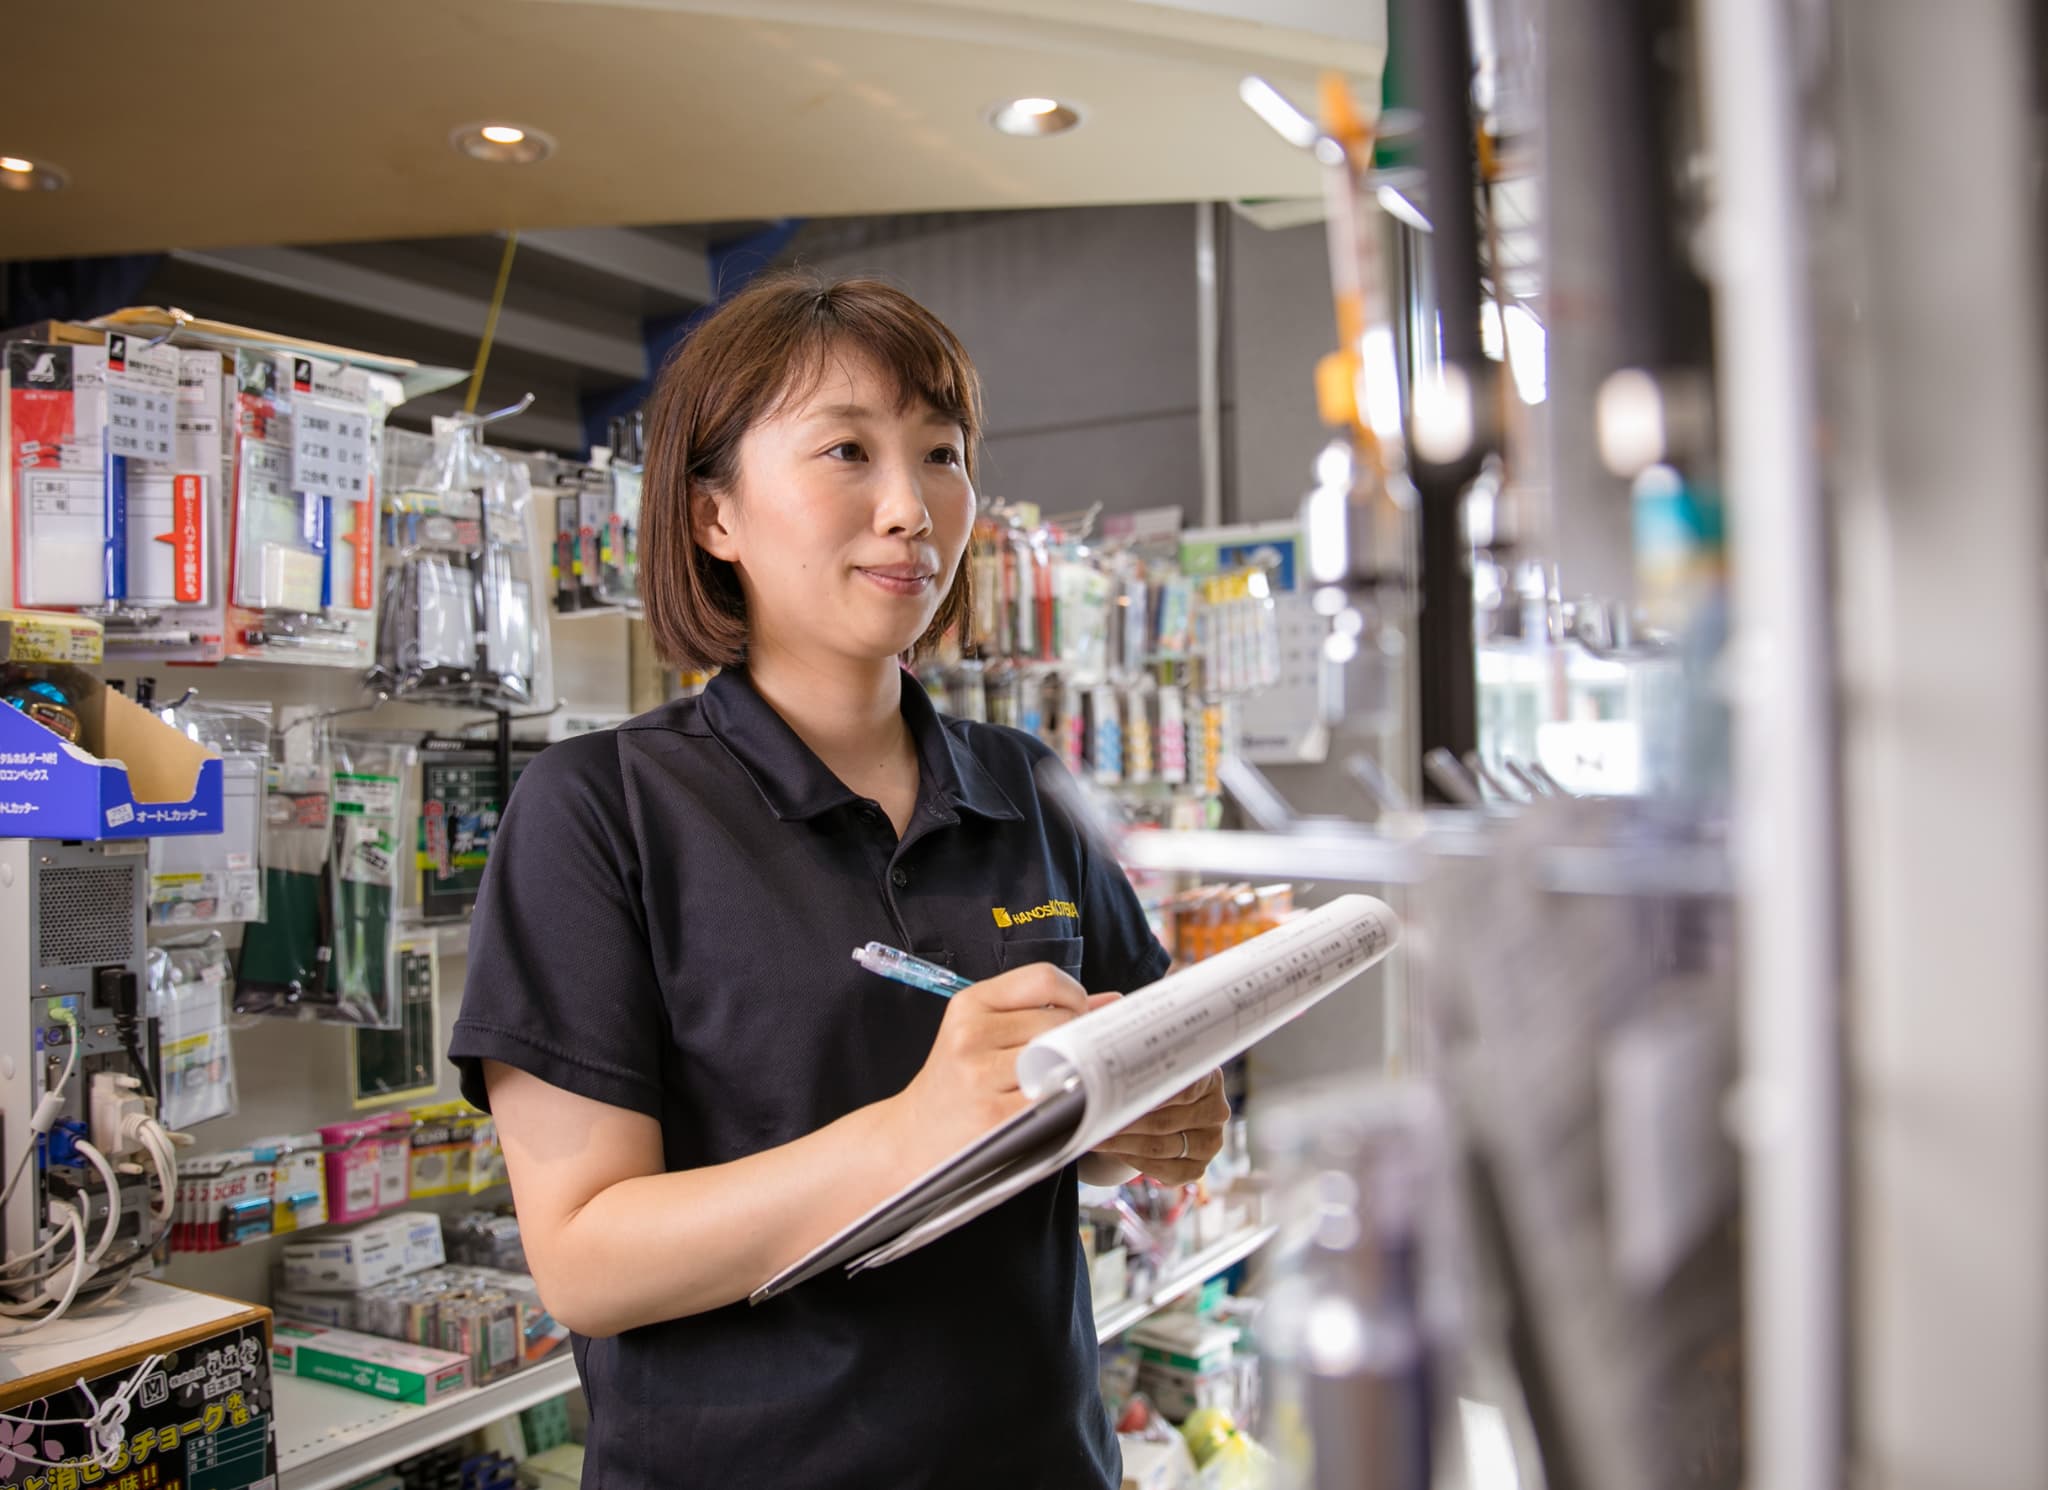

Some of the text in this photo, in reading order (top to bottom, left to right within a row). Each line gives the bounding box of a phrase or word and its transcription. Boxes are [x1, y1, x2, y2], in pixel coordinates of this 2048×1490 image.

[206, 1374, 240, 1395] 日本製
[226, 1391, 251, 1428] 水性
